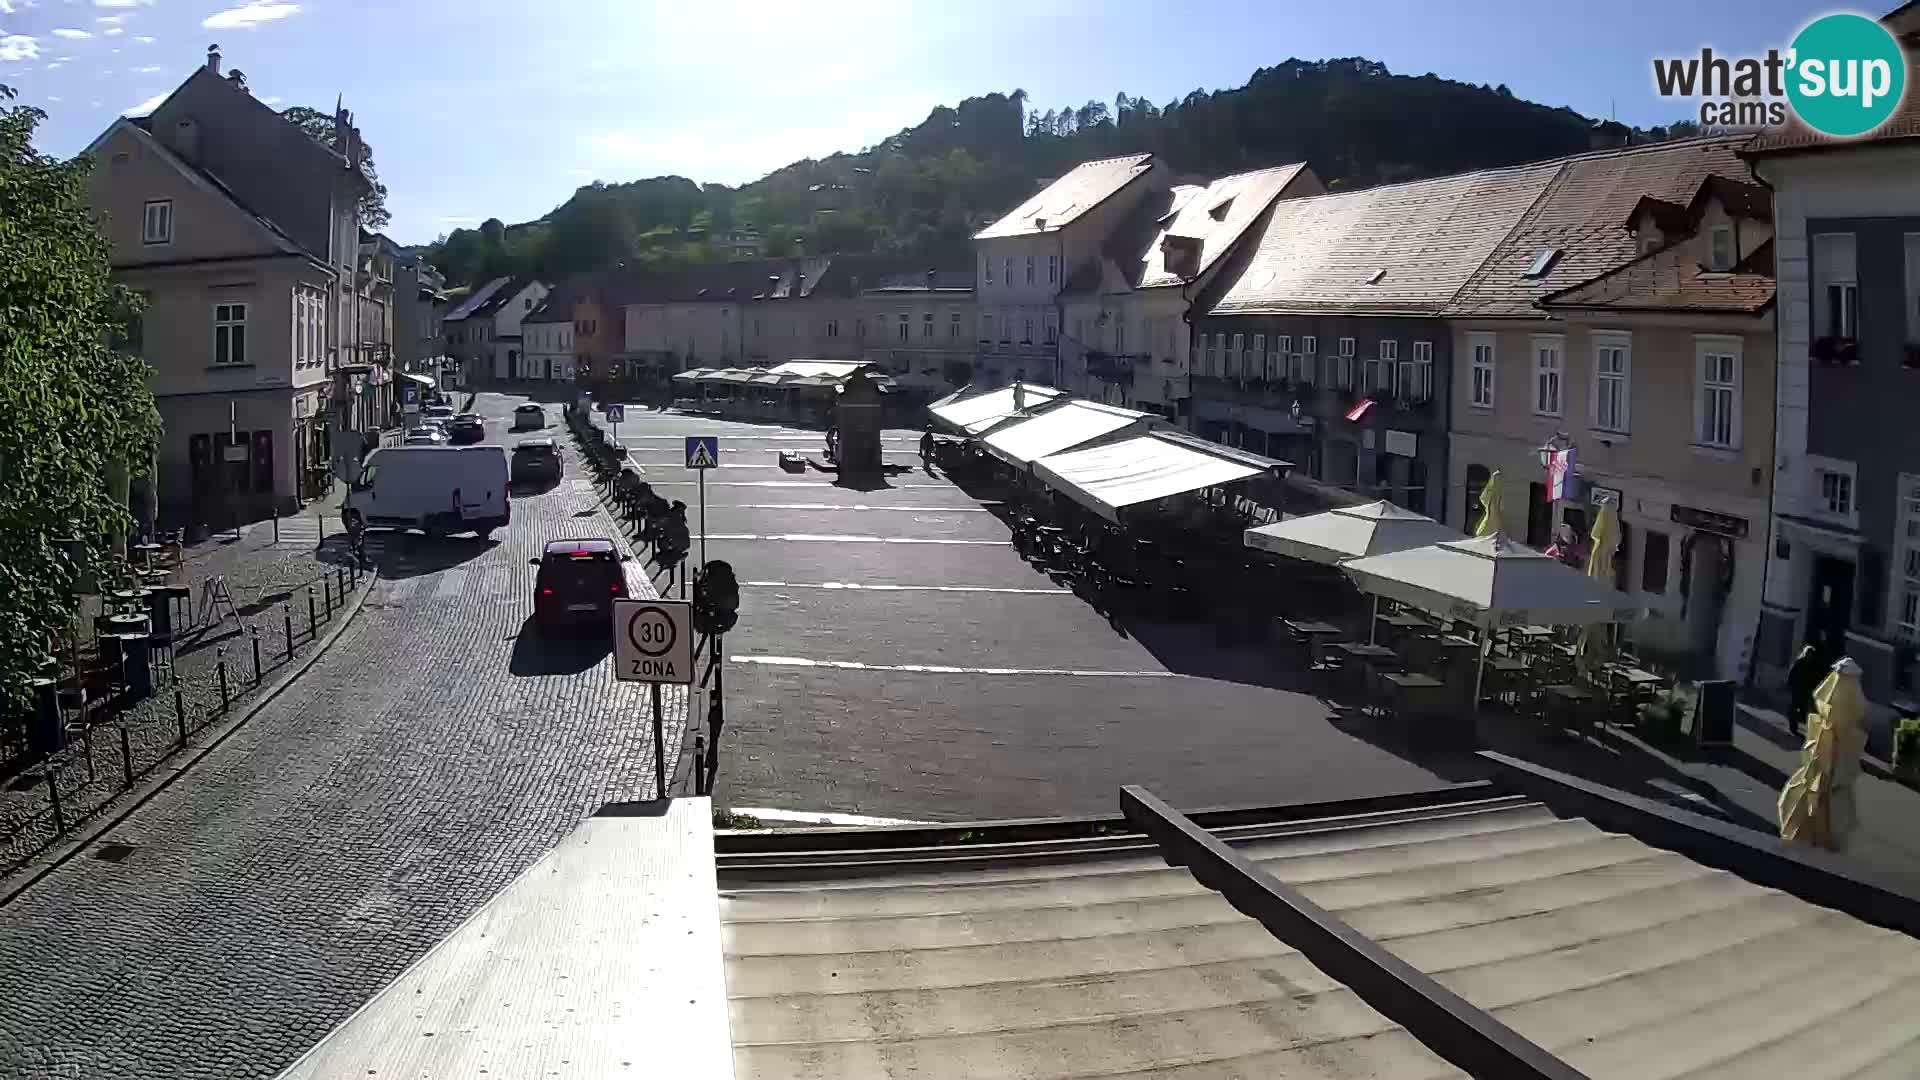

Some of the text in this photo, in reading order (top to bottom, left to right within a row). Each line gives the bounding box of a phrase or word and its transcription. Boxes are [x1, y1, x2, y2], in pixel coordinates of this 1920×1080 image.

[407, 391, 416, 402] P
[640, 622, 665, 643] 30
[631, 659, 676, 677] ZONA
